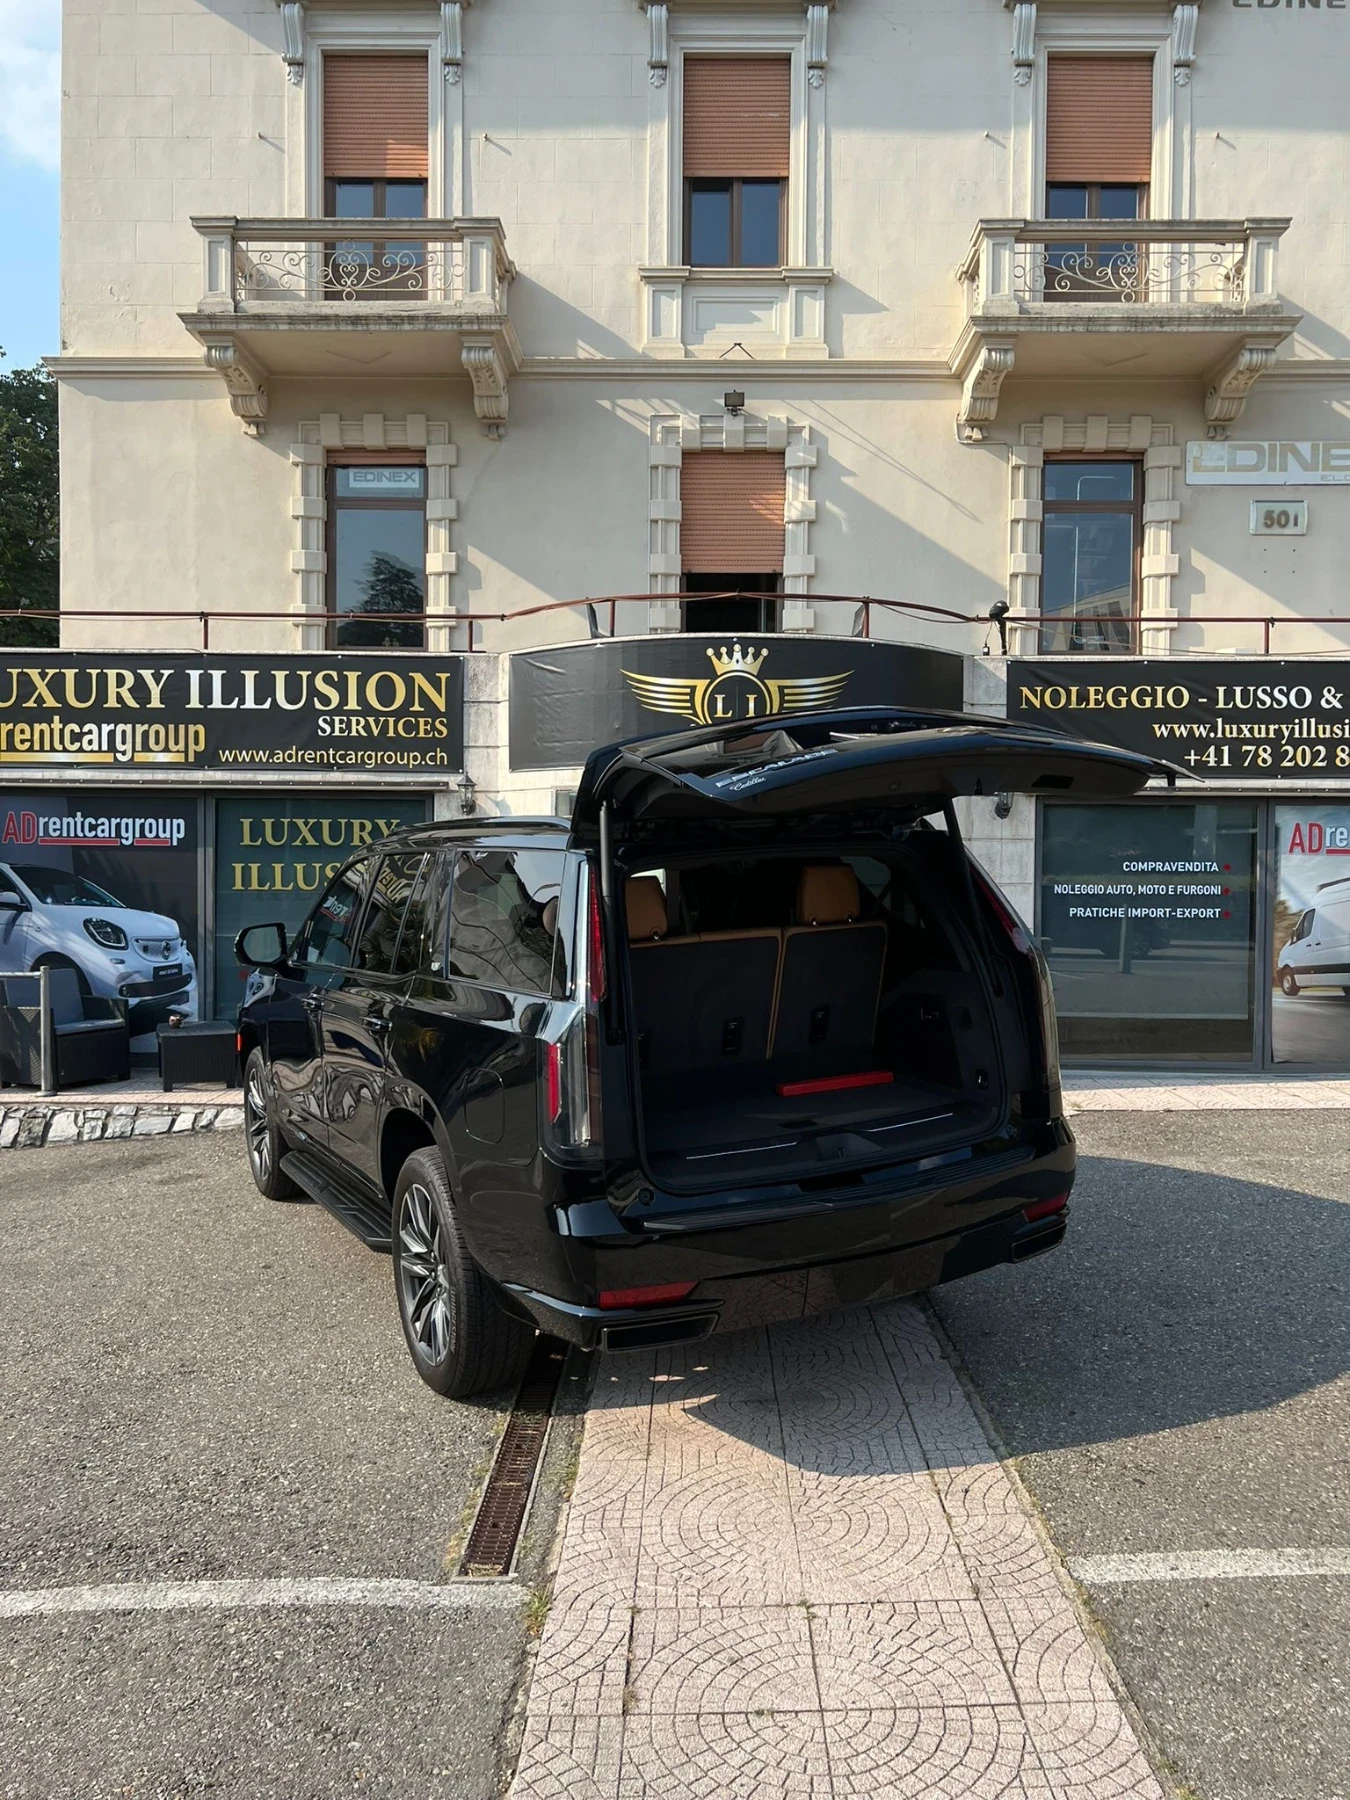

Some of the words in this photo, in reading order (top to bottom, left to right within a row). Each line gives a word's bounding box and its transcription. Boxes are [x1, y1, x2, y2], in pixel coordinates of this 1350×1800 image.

[353, 471, 416, 483] EDINEX
[1263, 510, 1299, 528] 501
[185, 670, 451, 712] ILLUSION
[1019, 686, 1190, 709] NOLEGGIO
[1215, 686, 1312, 709] LUSSO
[1320, 686, 1344, 709] &
[317, 716, 448, 739] SERVICES
[1153, 718, 1350, 745] www.luxuryillusi
[219, 744, 448, 768] www.adrentcargroup.ch
[1184, 745, 1232, 767] +41
[1242, 745, 1273, 767] 78
[1280, 745, 1327, 767] 202
[2, 811, 186, 847] ADrentcargroup
[240, 818, 400, 846] LUXURY
[1288, 822, 1348, 854] ADre
[1123, 862, 1219, 872] COMPRAVENDITA
[1054, 884, 1104, 895] NOLEGGIO
[1106, 884, 1136, 896] AUTO,
[1138, 884, 1166, 895] MOTO
[1168, 885, 1175, 895] E
[1177, 885, 1221, 895] FURGONI
[1069, 908, 1125, 917] PRATICHE
[1128, 908, 1221, 918] IMPORT-EXPORT
